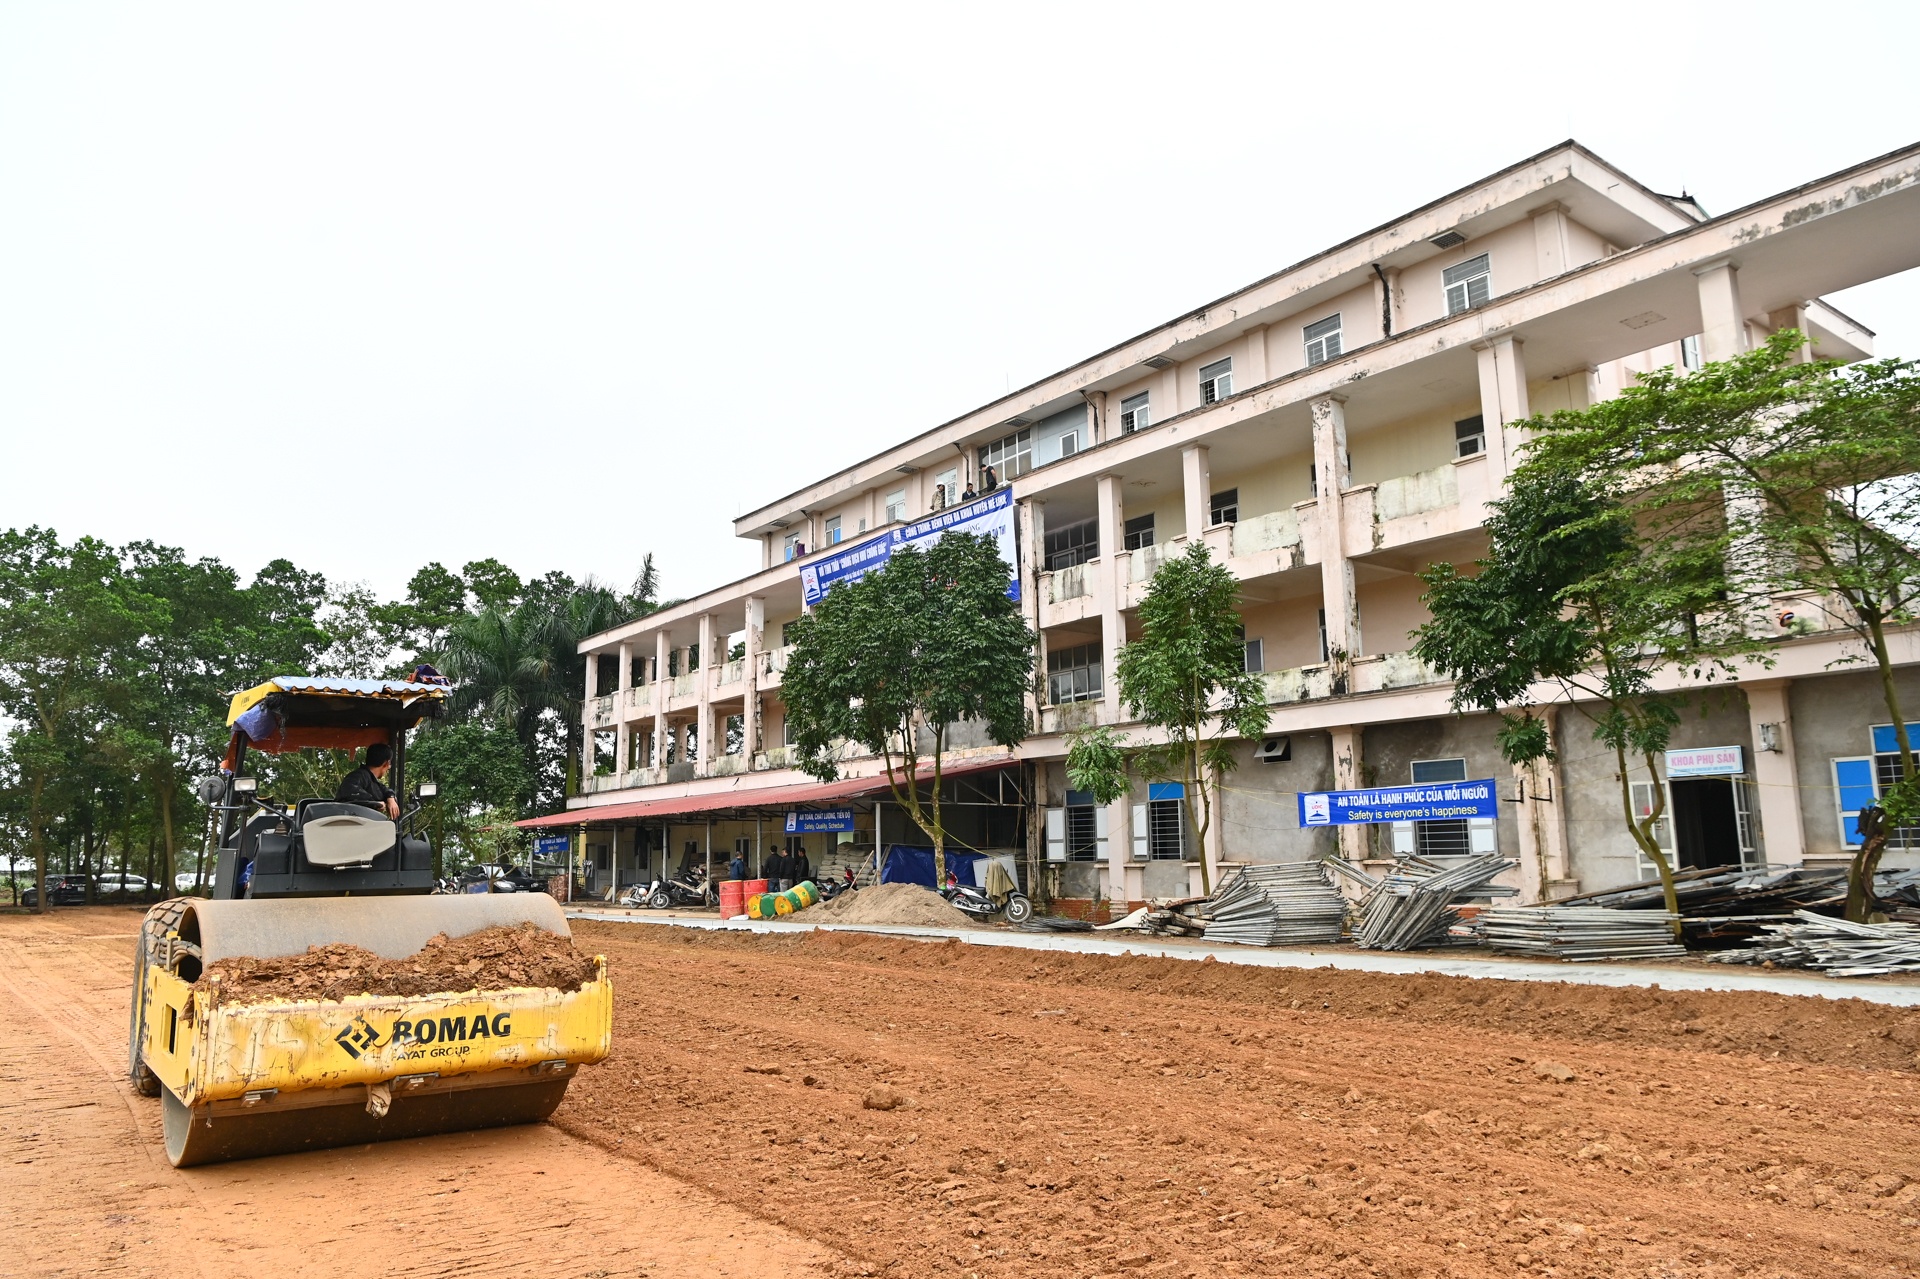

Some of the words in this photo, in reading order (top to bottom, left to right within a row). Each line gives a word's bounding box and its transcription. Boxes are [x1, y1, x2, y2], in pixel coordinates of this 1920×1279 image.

[1671, 757, 1694, 766] KHOA
[1697, 755, 1714, 766] PHỤ
[1338, 797, 1348, 807] AN
[1348, 793, 1369, 806] TOÀN
[1370, 792, 1381, 805] LÀ
[1381, 792, 1402, 807] HẠNH
[1403, 788, 1424, 803] PHÚC
[1426, 786, 1443, 802] CỦA
[1444, 784, 1460, 800] MỖI
[1462, 784, 1488, 800] NGƯỜI
[1348, 810, 1373, 821] Safety
[1375, 809, 1382, 819] is
[1384, 807, 1430, 820] everyone's
[1431, 805, 1478, 818] happiness
[392, 1012, 511, 1044] BOMAG
[430, 1046, 470, 1057] GROUP
